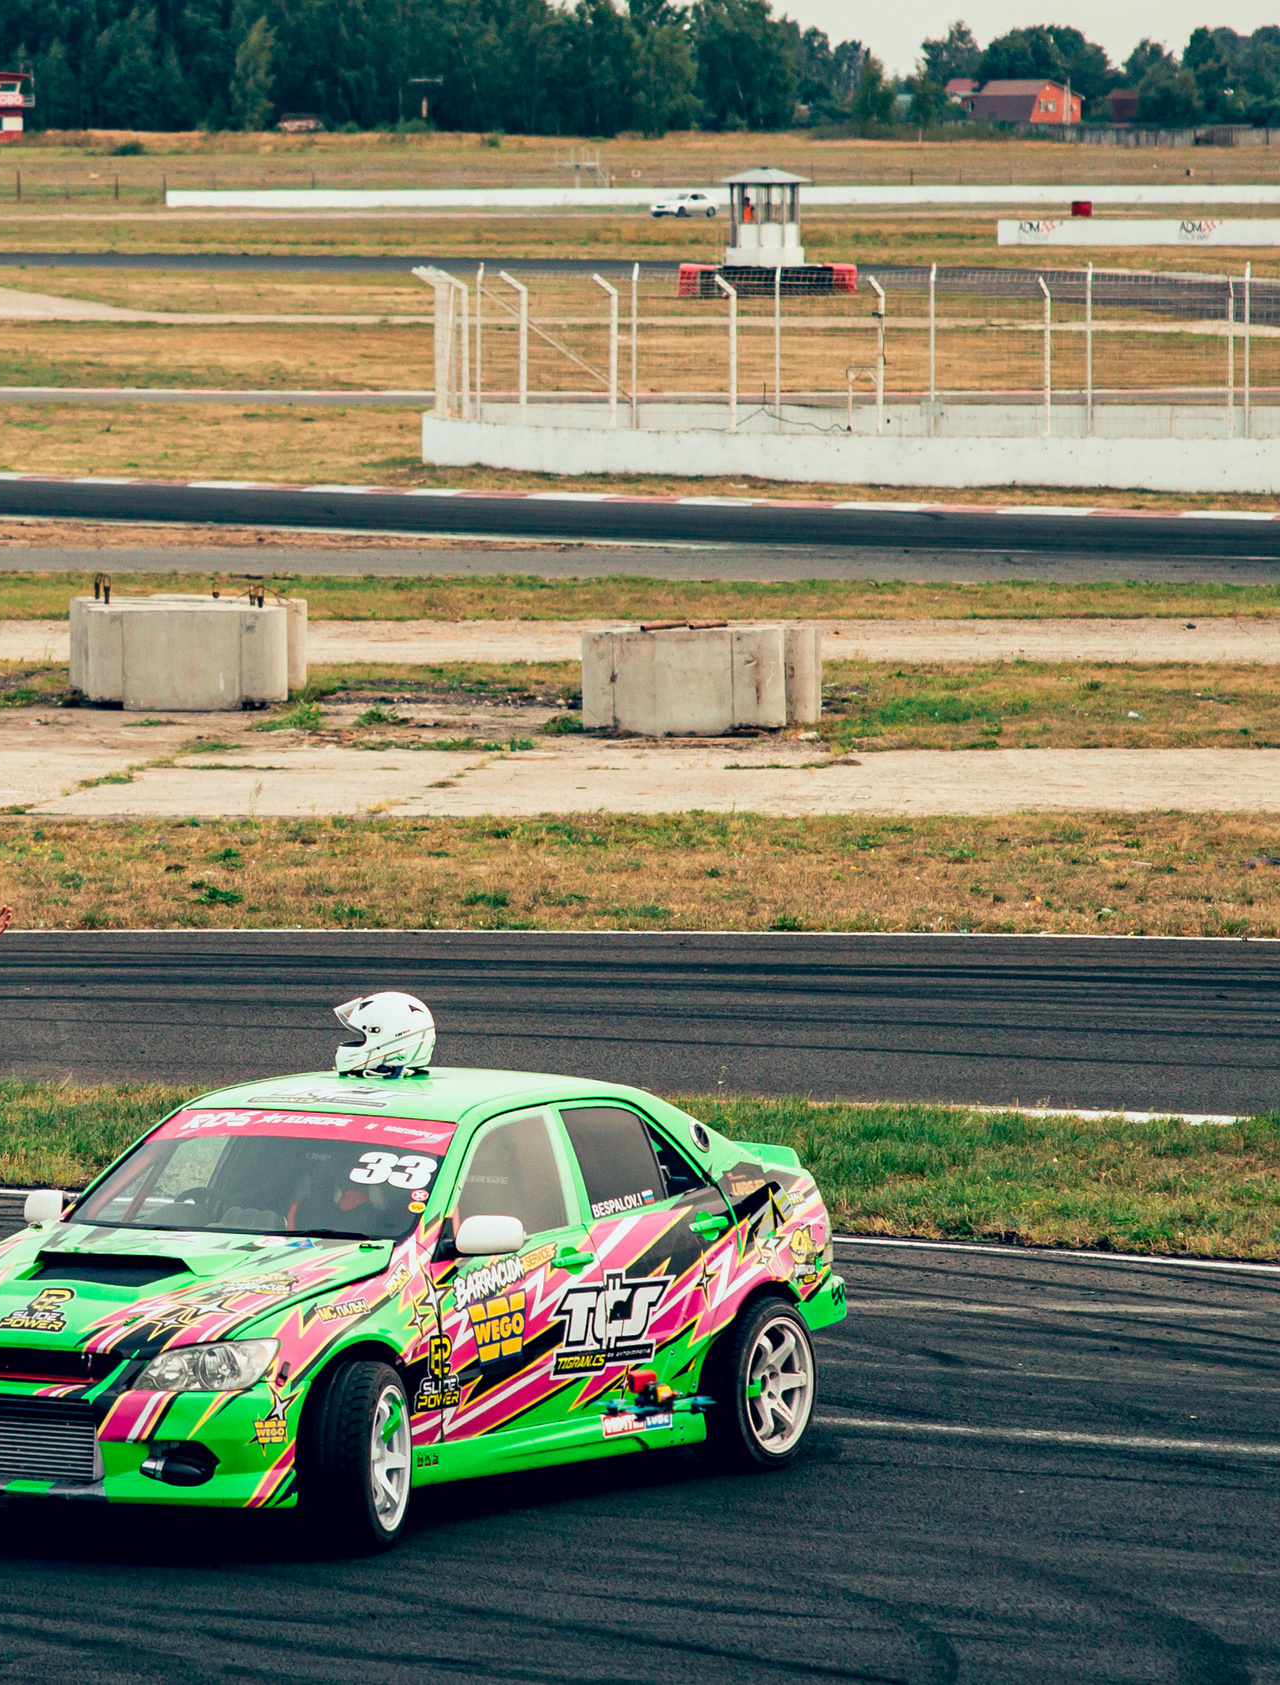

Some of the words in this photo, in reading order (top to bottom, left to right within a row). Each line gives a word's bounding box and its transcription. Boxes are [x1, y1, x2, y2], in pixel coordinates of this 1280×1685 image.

[180, 1111, 263, 1130] RDS
[280, 1115, 354, 1128] EUROPE
[349, 1151, 438, 1190] 33
[591, 1193, 643, 1218] BESPALOV.I
[453, 1254, 525, 1311] BARRACUDA
[525, 1247, 552, 1267] SERVICE
[0, 1318, 64, 1331] POWER
[12, 1310, 61, 1321] SLIDE
[473, 1312, 525, 1345] WEGO
[423, 1378, 457, 1395] SLIDE
[417, 1390, 460, 1409] POWER
[256, 1427, 285, 1437] WEGO
